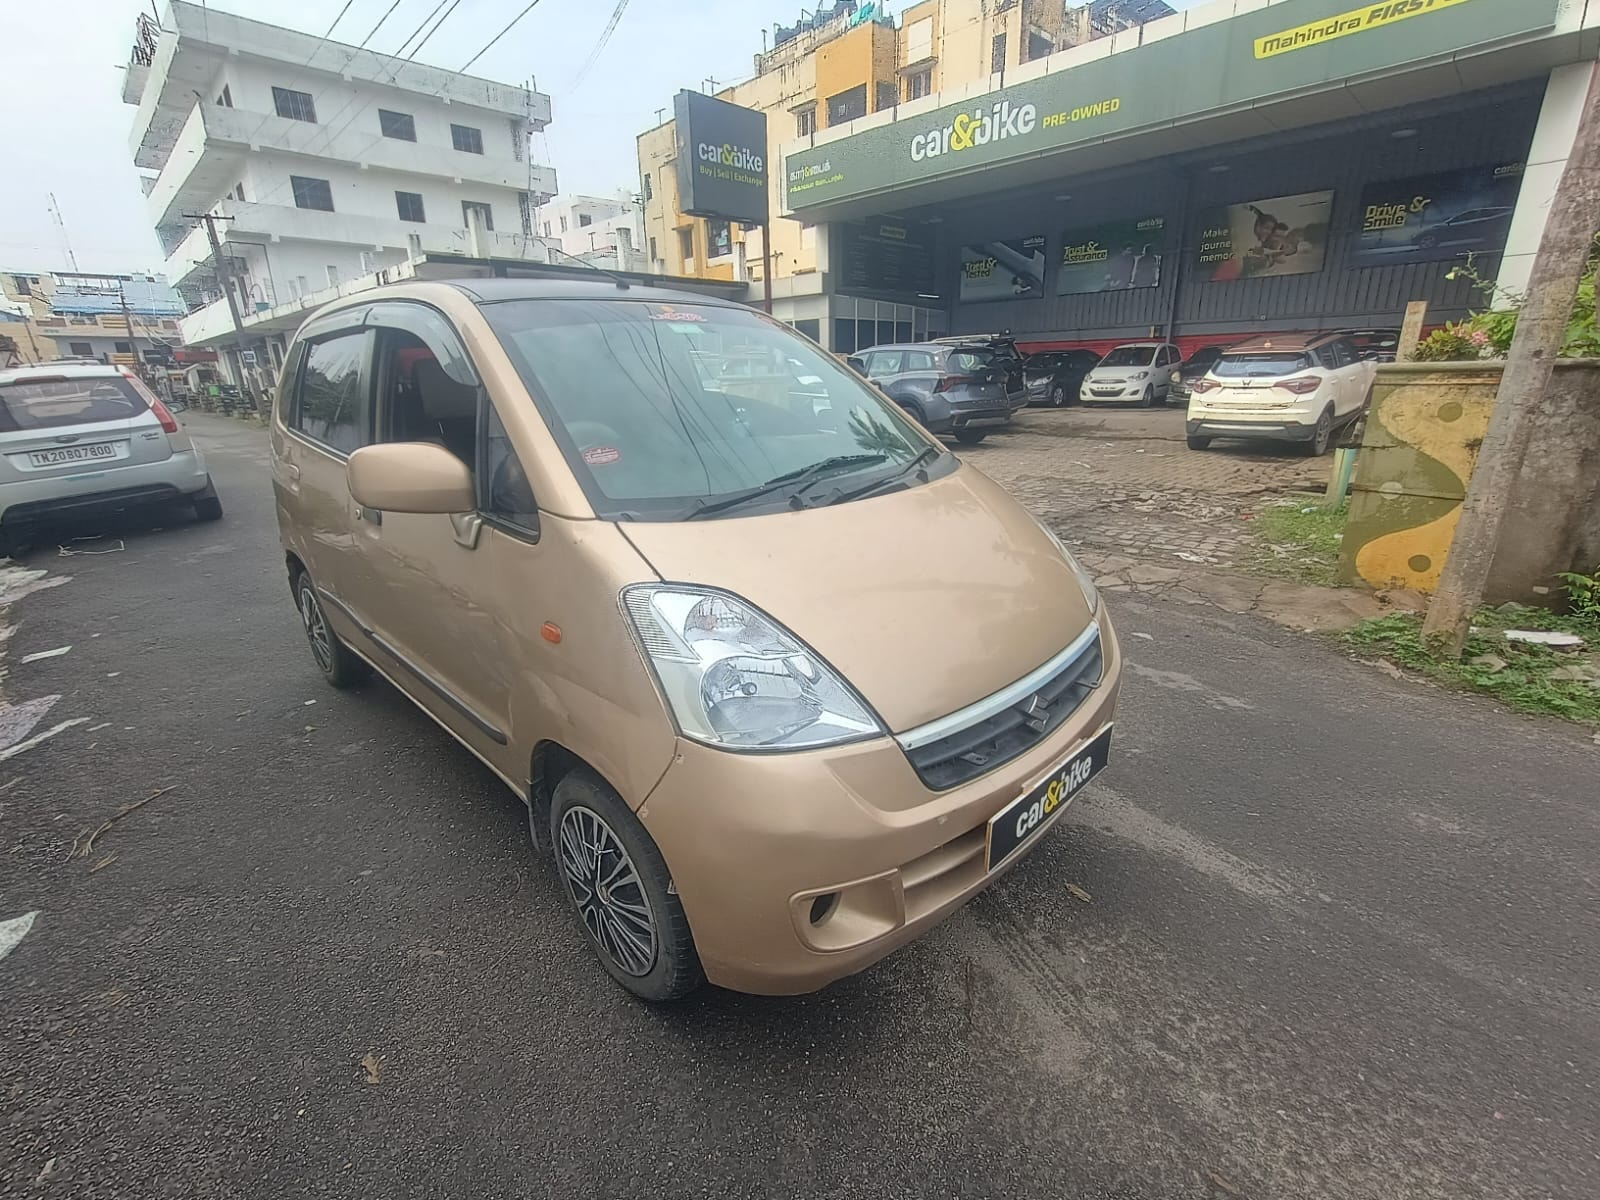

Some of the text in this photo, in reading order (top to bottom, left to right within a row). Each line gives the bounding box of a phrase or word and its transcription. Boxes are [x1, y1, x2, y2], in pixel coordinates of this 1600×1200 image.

[1262, 16, 1361, 54] Mahindra
[911, 98, 1120, 162] car&bike PRE-OWNED
[698, 143, 763, 173] car&bike
[700, 165, 763, 187] Buy Sell Exchange
[1365, 196, 1431, 219] Drive &
[1363, 212, 1406, 228] Smile
[1202, 227, 1229, 239] Make
[1064, 244, 1086, 256] Trust
[1016, 756, 1092, 838] car&bike
